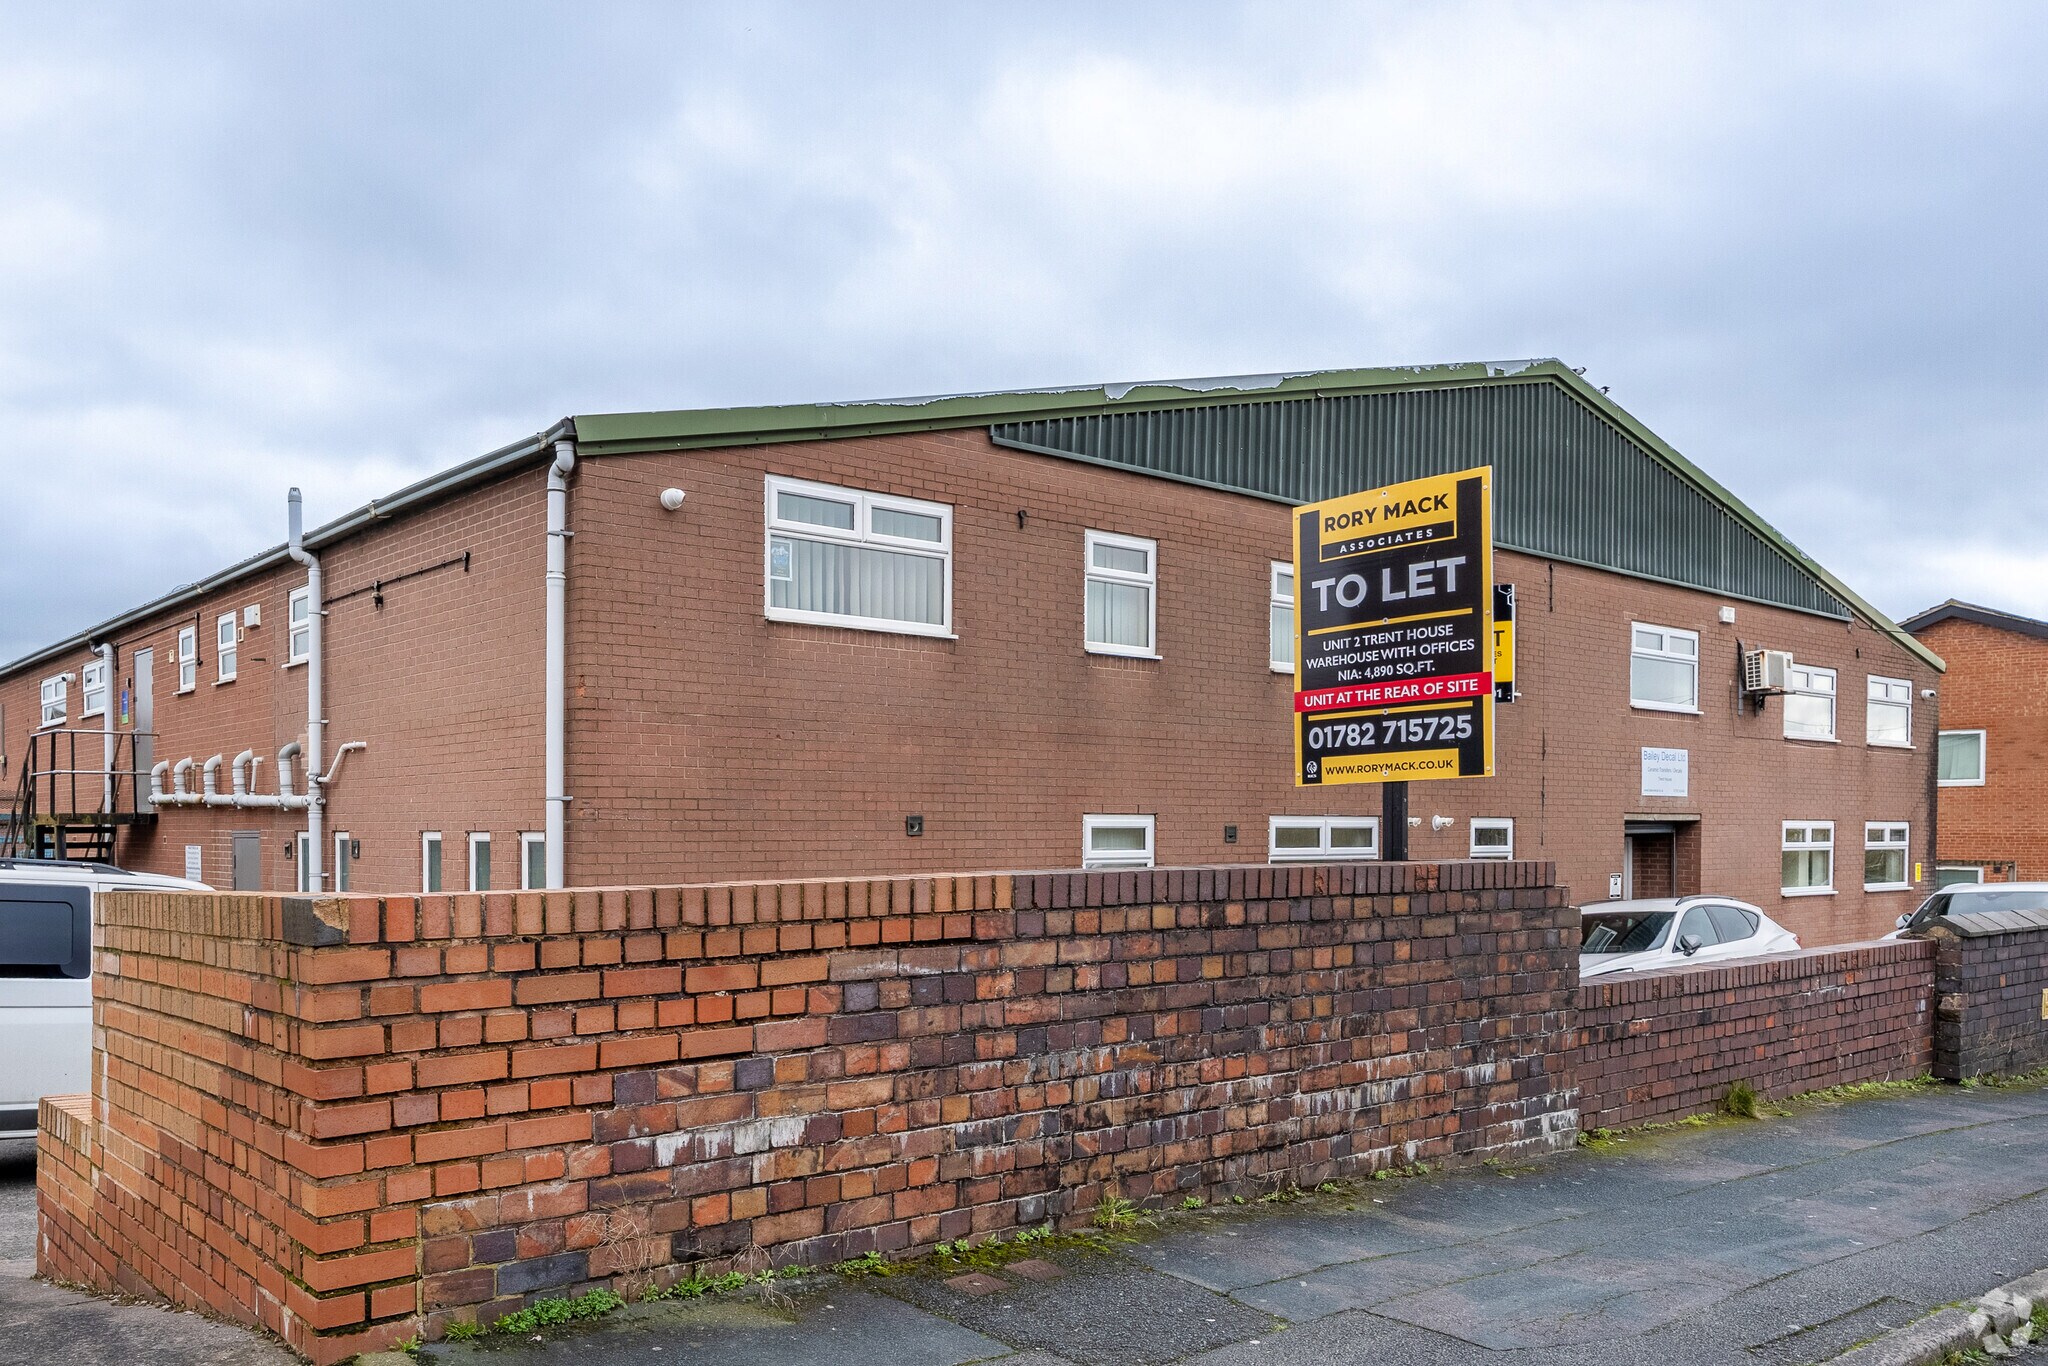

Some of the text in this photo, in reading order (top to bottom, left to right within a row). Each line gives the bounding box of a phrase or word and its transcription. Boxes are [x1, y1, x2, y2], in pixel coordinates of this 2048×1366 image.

[1324, 493, 1449, 532] RORY MACK
[1339, 529, 1433, 553] ASSOCIATES
[1311, 556, 1466, 612] TO LET
[1323, 624, 1454, 651] UNIT 2 TRENT HOUSE
[1306, 650, 1379, 669] WAREHOUSE
[1380, 645, 1416, 660] WITH
[1419, 638, 1475, 655] OFFICES
[1338, 660, 1436, 682] NIA: 4,890 SQ.FT.
[1304, 678, 1478, 707] UNIT AT THE REAR OF SITE
[1308, 714, 1472, 750] 01782 715725
[1325, 759, 1454, 775] WWW.RORYMACK.CO.UK
